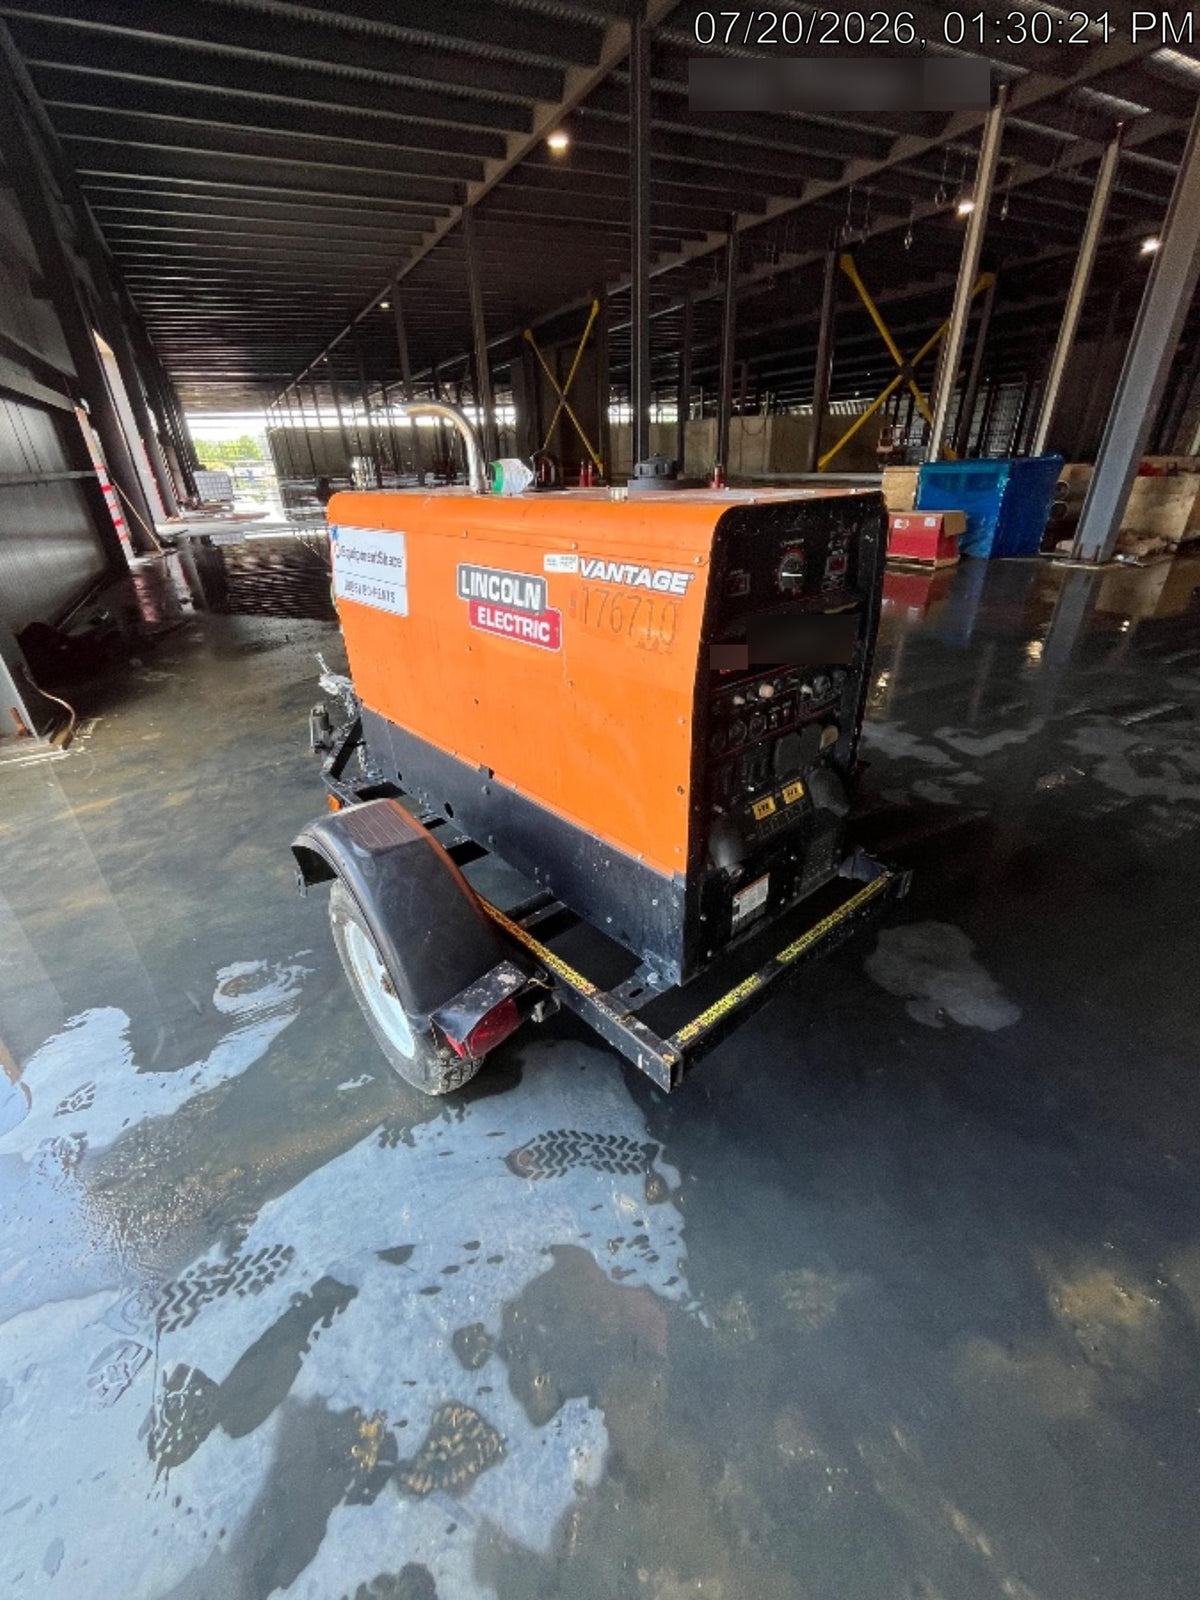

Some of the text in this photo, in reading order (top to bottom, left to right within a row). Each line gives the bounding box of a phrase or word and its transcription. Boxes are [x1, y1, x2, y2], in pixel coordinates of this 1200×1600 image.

[459, 569, 542, 611] LINCOLN
[578, 557, 691, 595] VANTAGE
[477, 606, 551, 643] ELECTRIC
